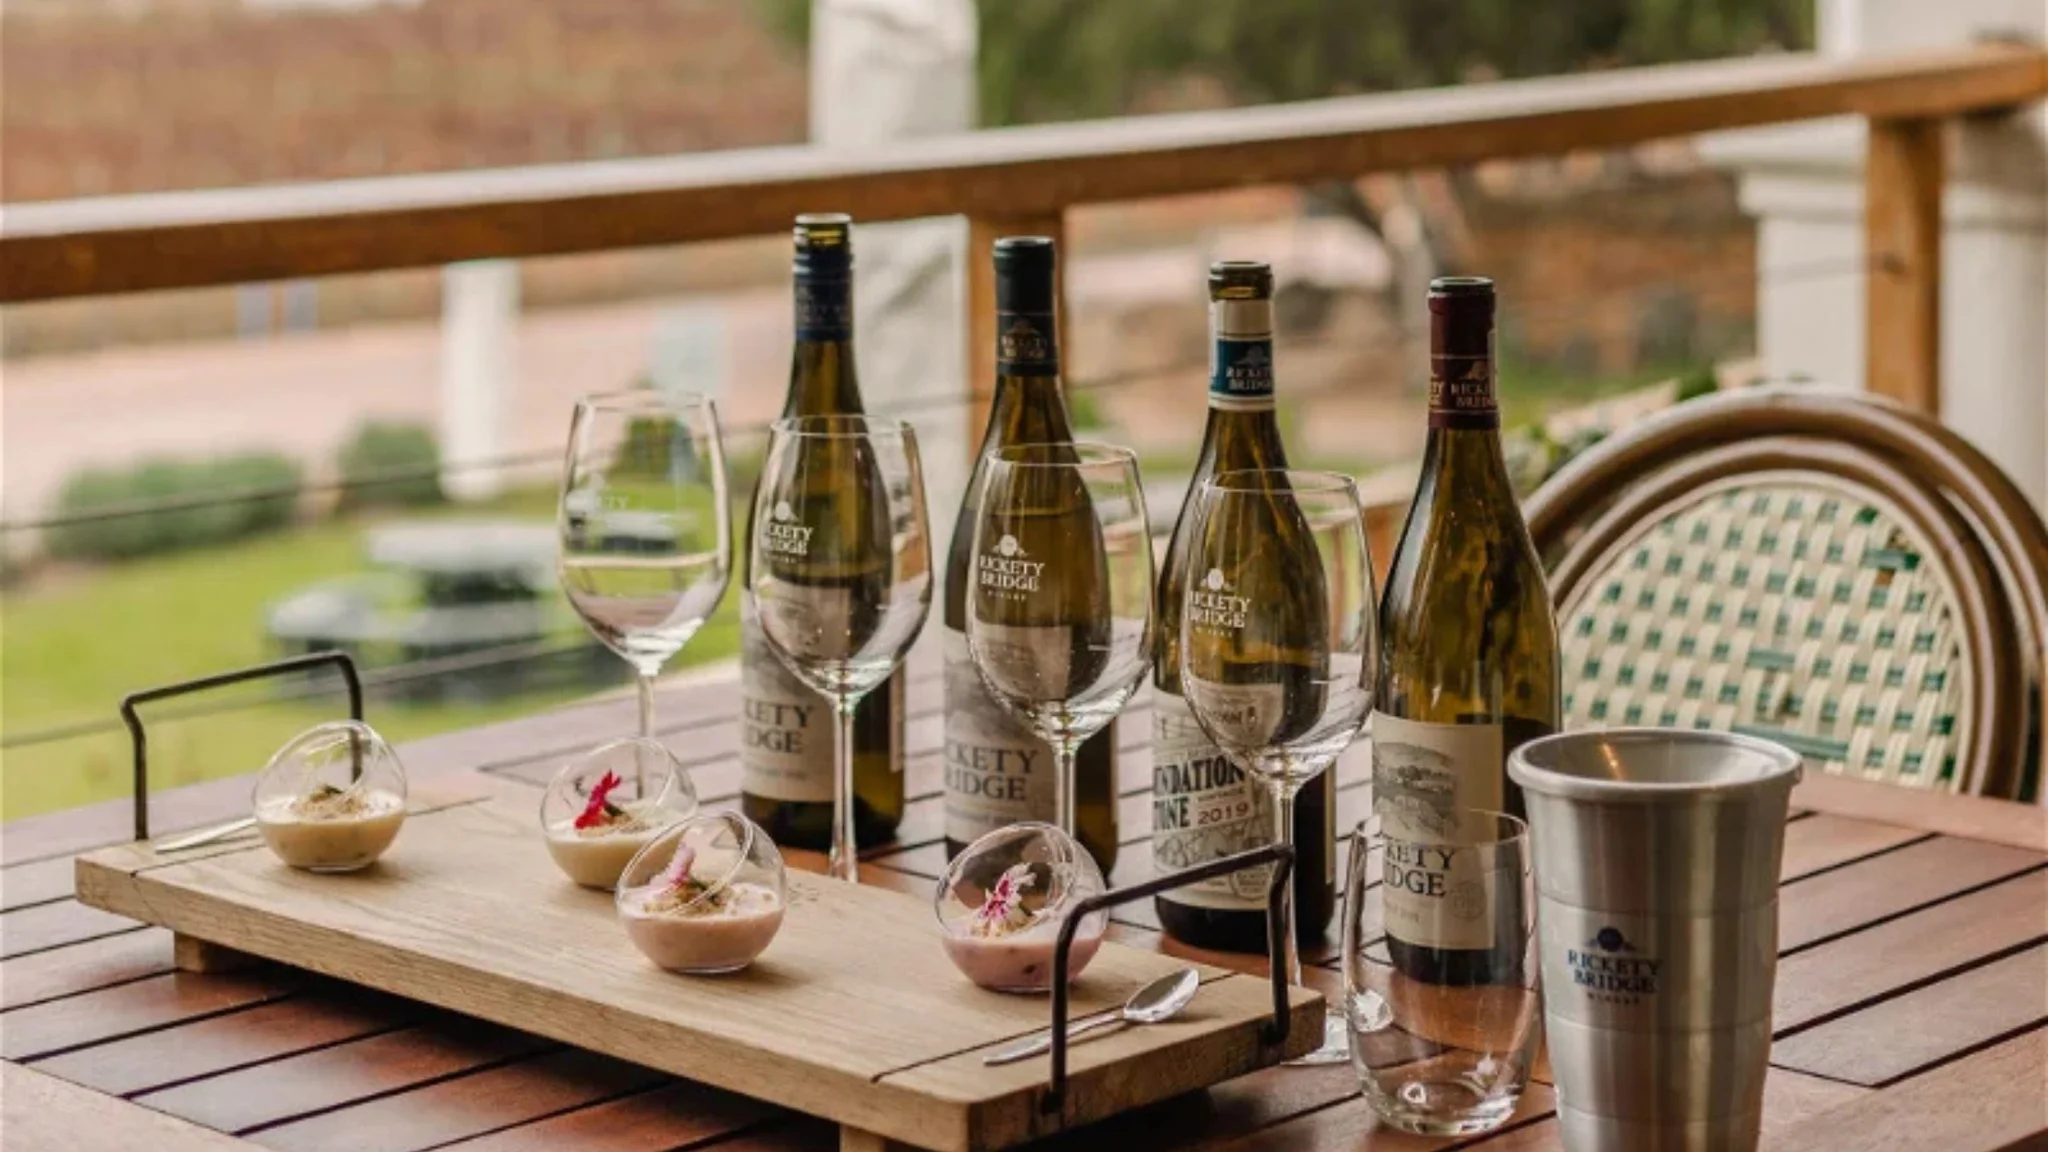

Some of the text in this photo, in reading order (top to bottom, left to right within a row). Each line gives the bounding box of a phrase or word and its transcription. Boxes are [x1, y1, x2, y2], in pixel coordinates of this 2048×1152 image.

[980, 555, 1045, 577] RICKETY
[981, 570, 1039, 592] BRIDGE
[1198, 802, 1249, 824] 2019
[1568, 949, 1662, 976] RICKETY
[1574, 969, 1658, 995] BRIDGE
